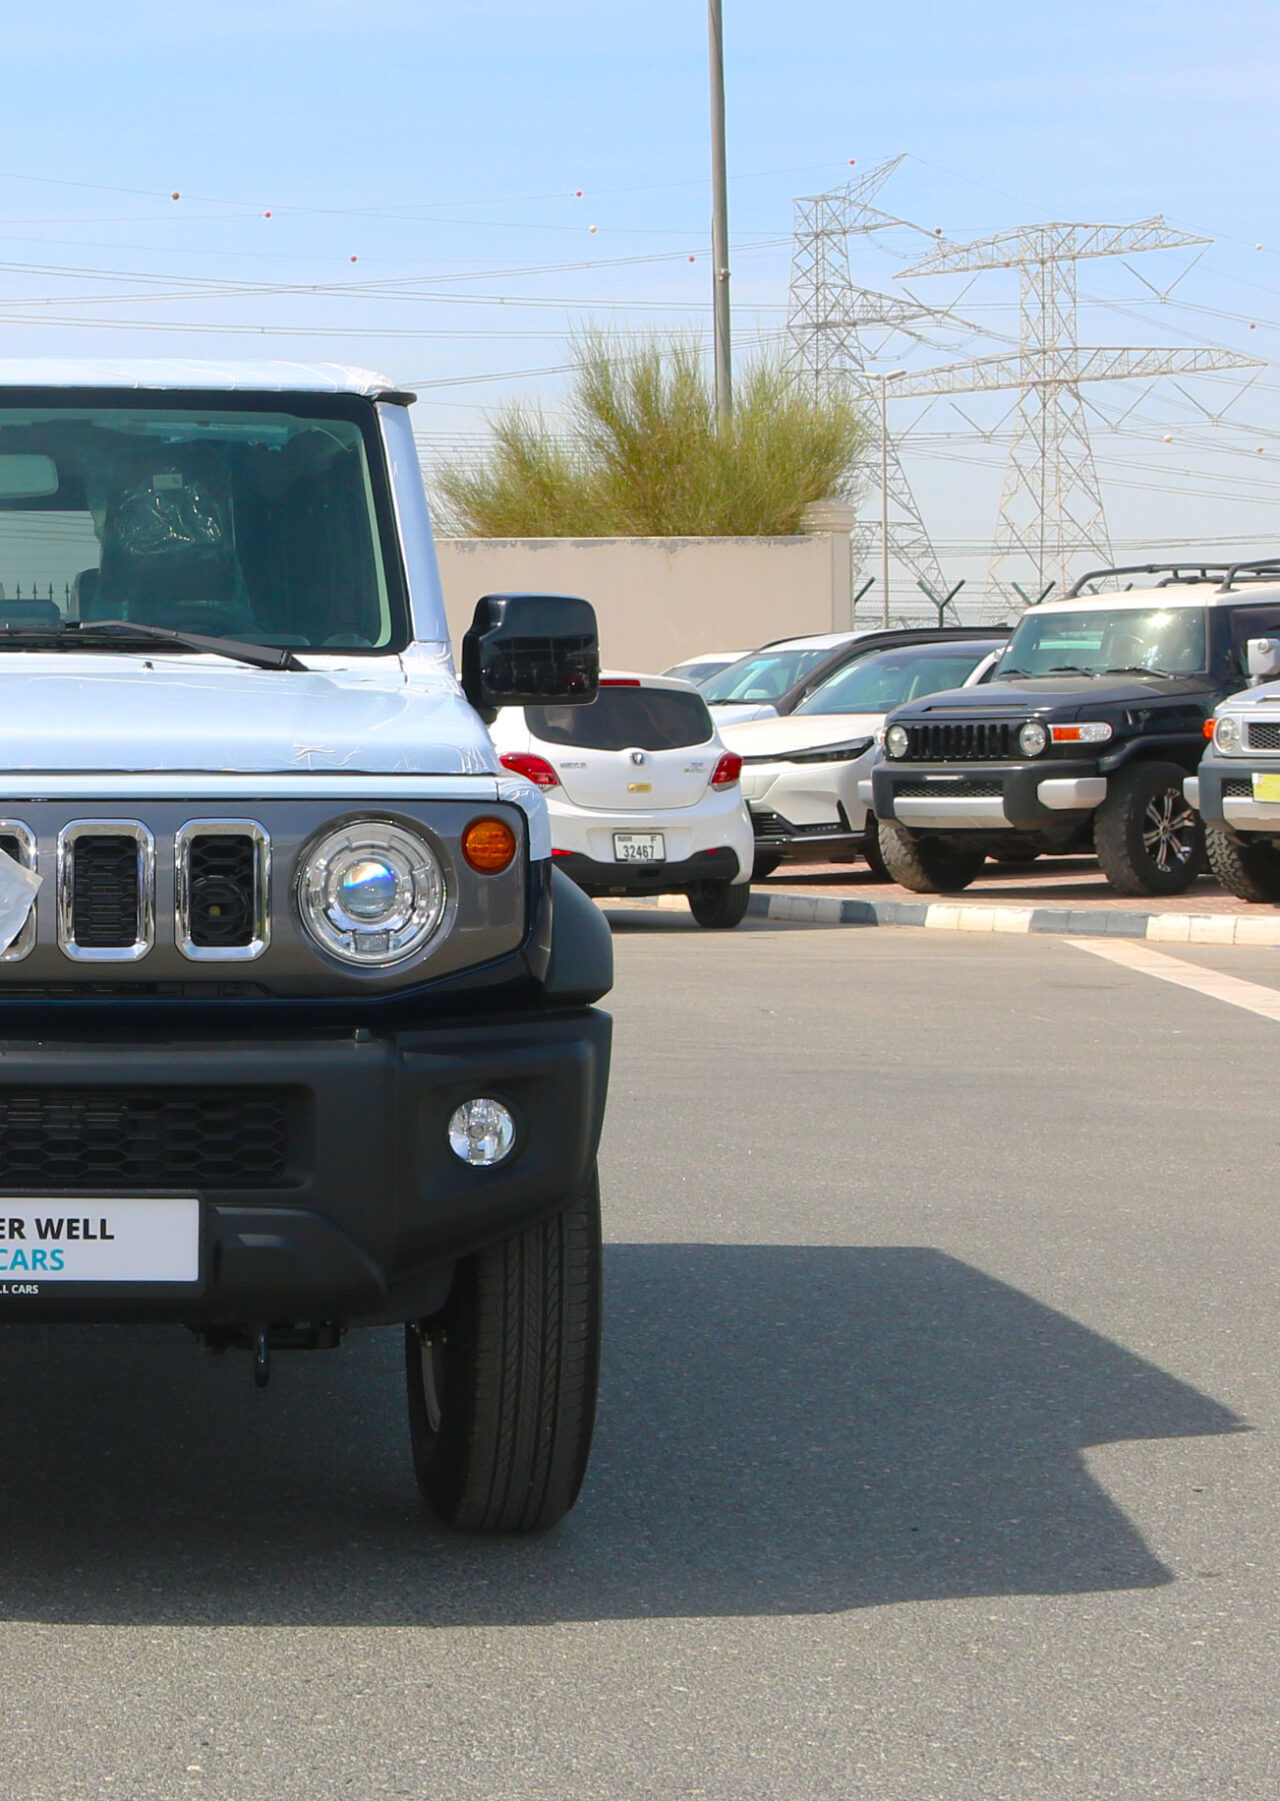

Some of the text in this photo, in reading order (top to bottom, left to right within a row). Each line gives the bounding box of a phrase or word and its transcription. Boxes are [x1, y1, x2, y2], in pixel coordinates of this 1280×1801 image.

[623, 844, 655, 859] 32467
[34, 1217, 115, 1240] WELL
[11, 1284, 39, 1295] CARS
